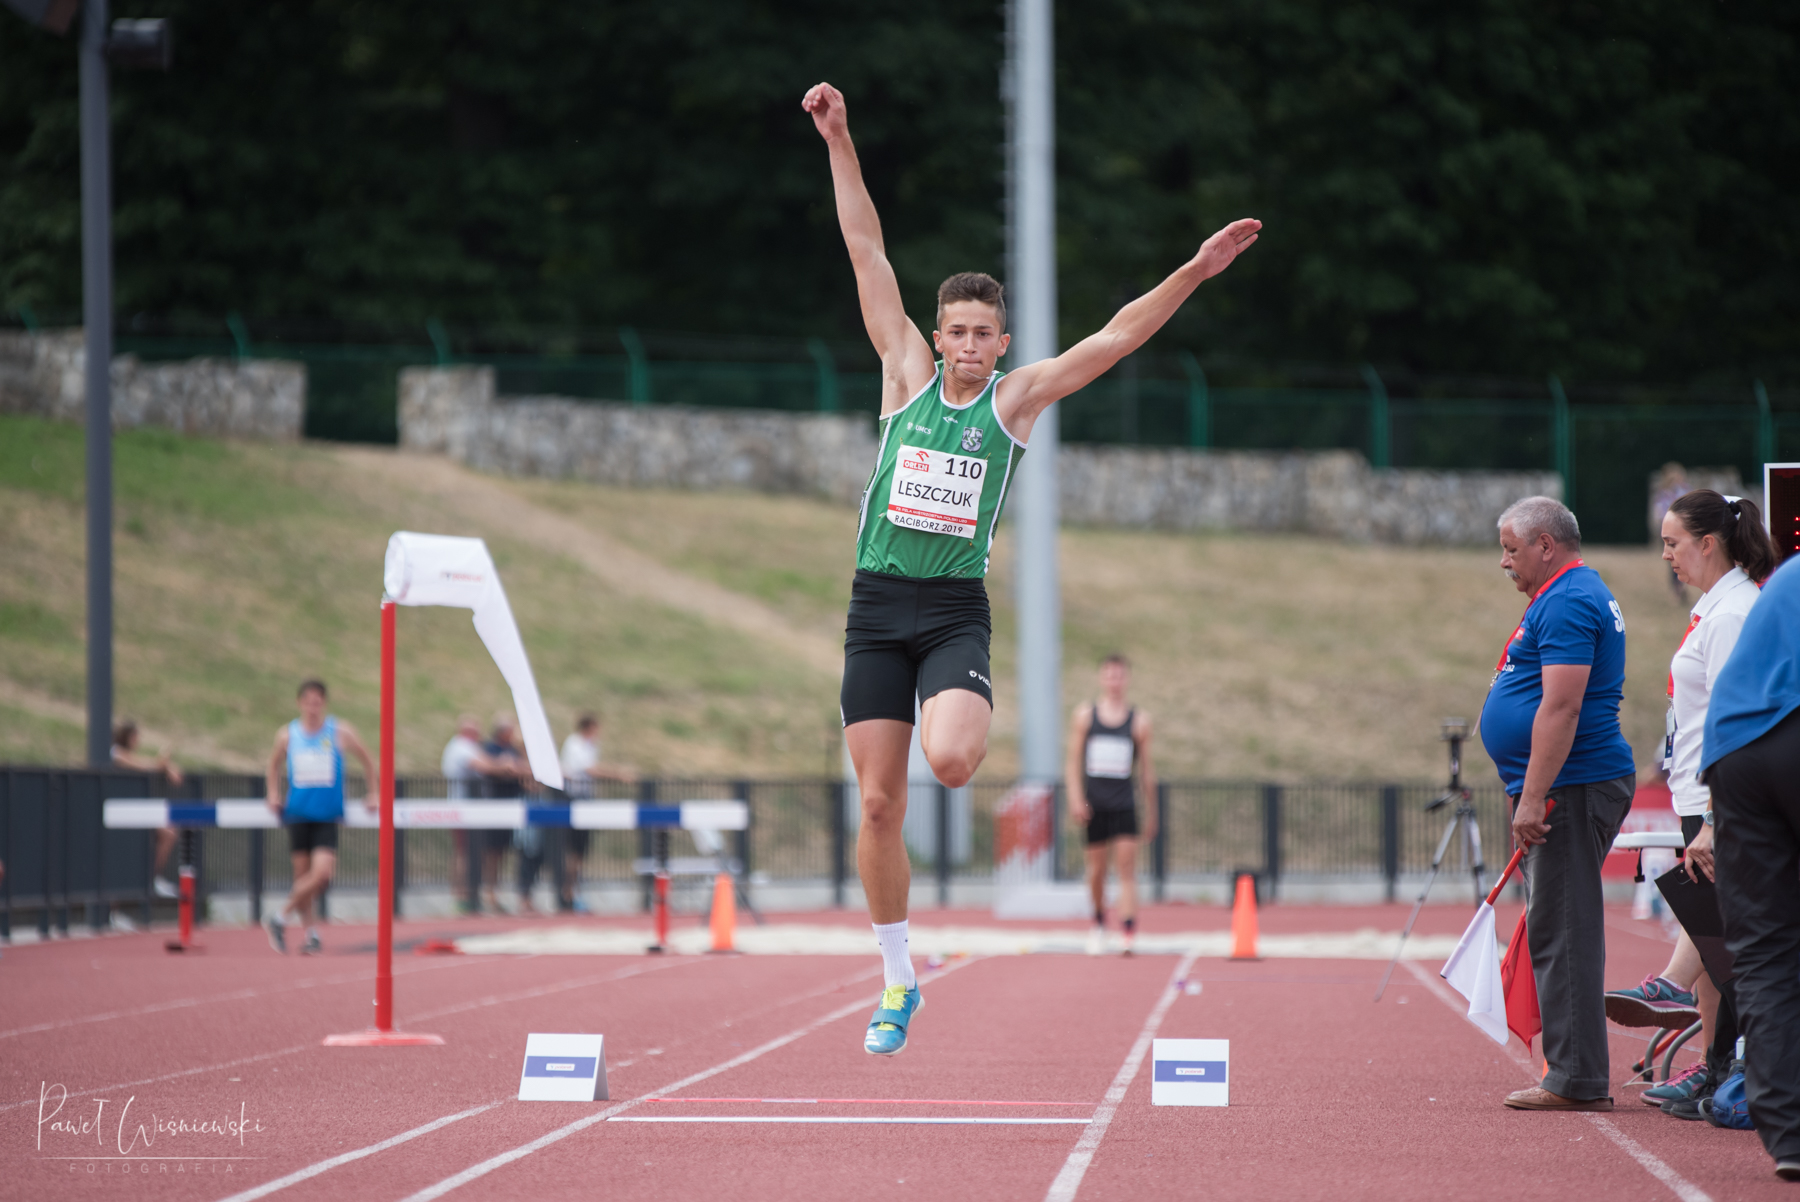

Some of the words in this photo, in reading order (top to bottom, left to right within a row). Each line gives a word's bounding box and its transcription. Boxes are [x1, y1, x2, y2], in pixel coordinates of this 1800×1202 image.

[915, 424, 932, 435] UMCS
[904, 461, 928, 472] ORLEN
[945, 457, 982, 480] 110
[898, 480, 973, 507] LESZCZUK
[894, 514, 940, 531] RACIBÓRZ
[941, 524, 963, 534] 2019
